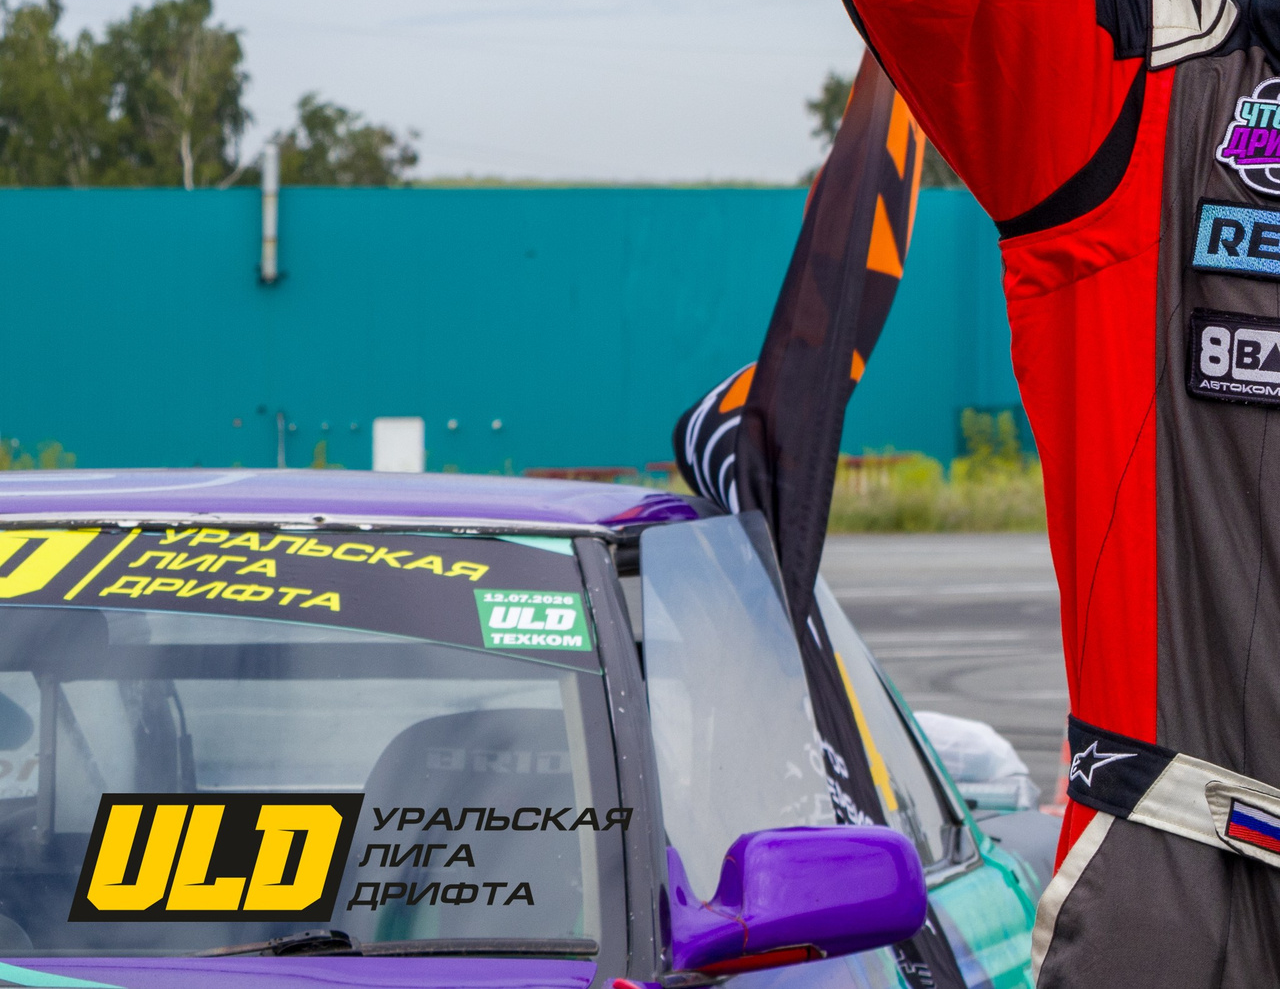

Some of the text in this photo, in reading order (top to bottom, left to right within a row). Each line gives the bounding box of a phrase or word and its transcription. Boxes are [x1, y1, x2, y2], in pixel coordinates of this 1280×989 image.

[129, 551, 277, 577] ЛИГА
[158, 528, 490, 581] УРАЛЬСКАЯ
[99, 575, 341, 611] ДРИФТА
[488, 606, 577, 631] ULD
[490, 633, 583, 647] ТЕХКОМ
